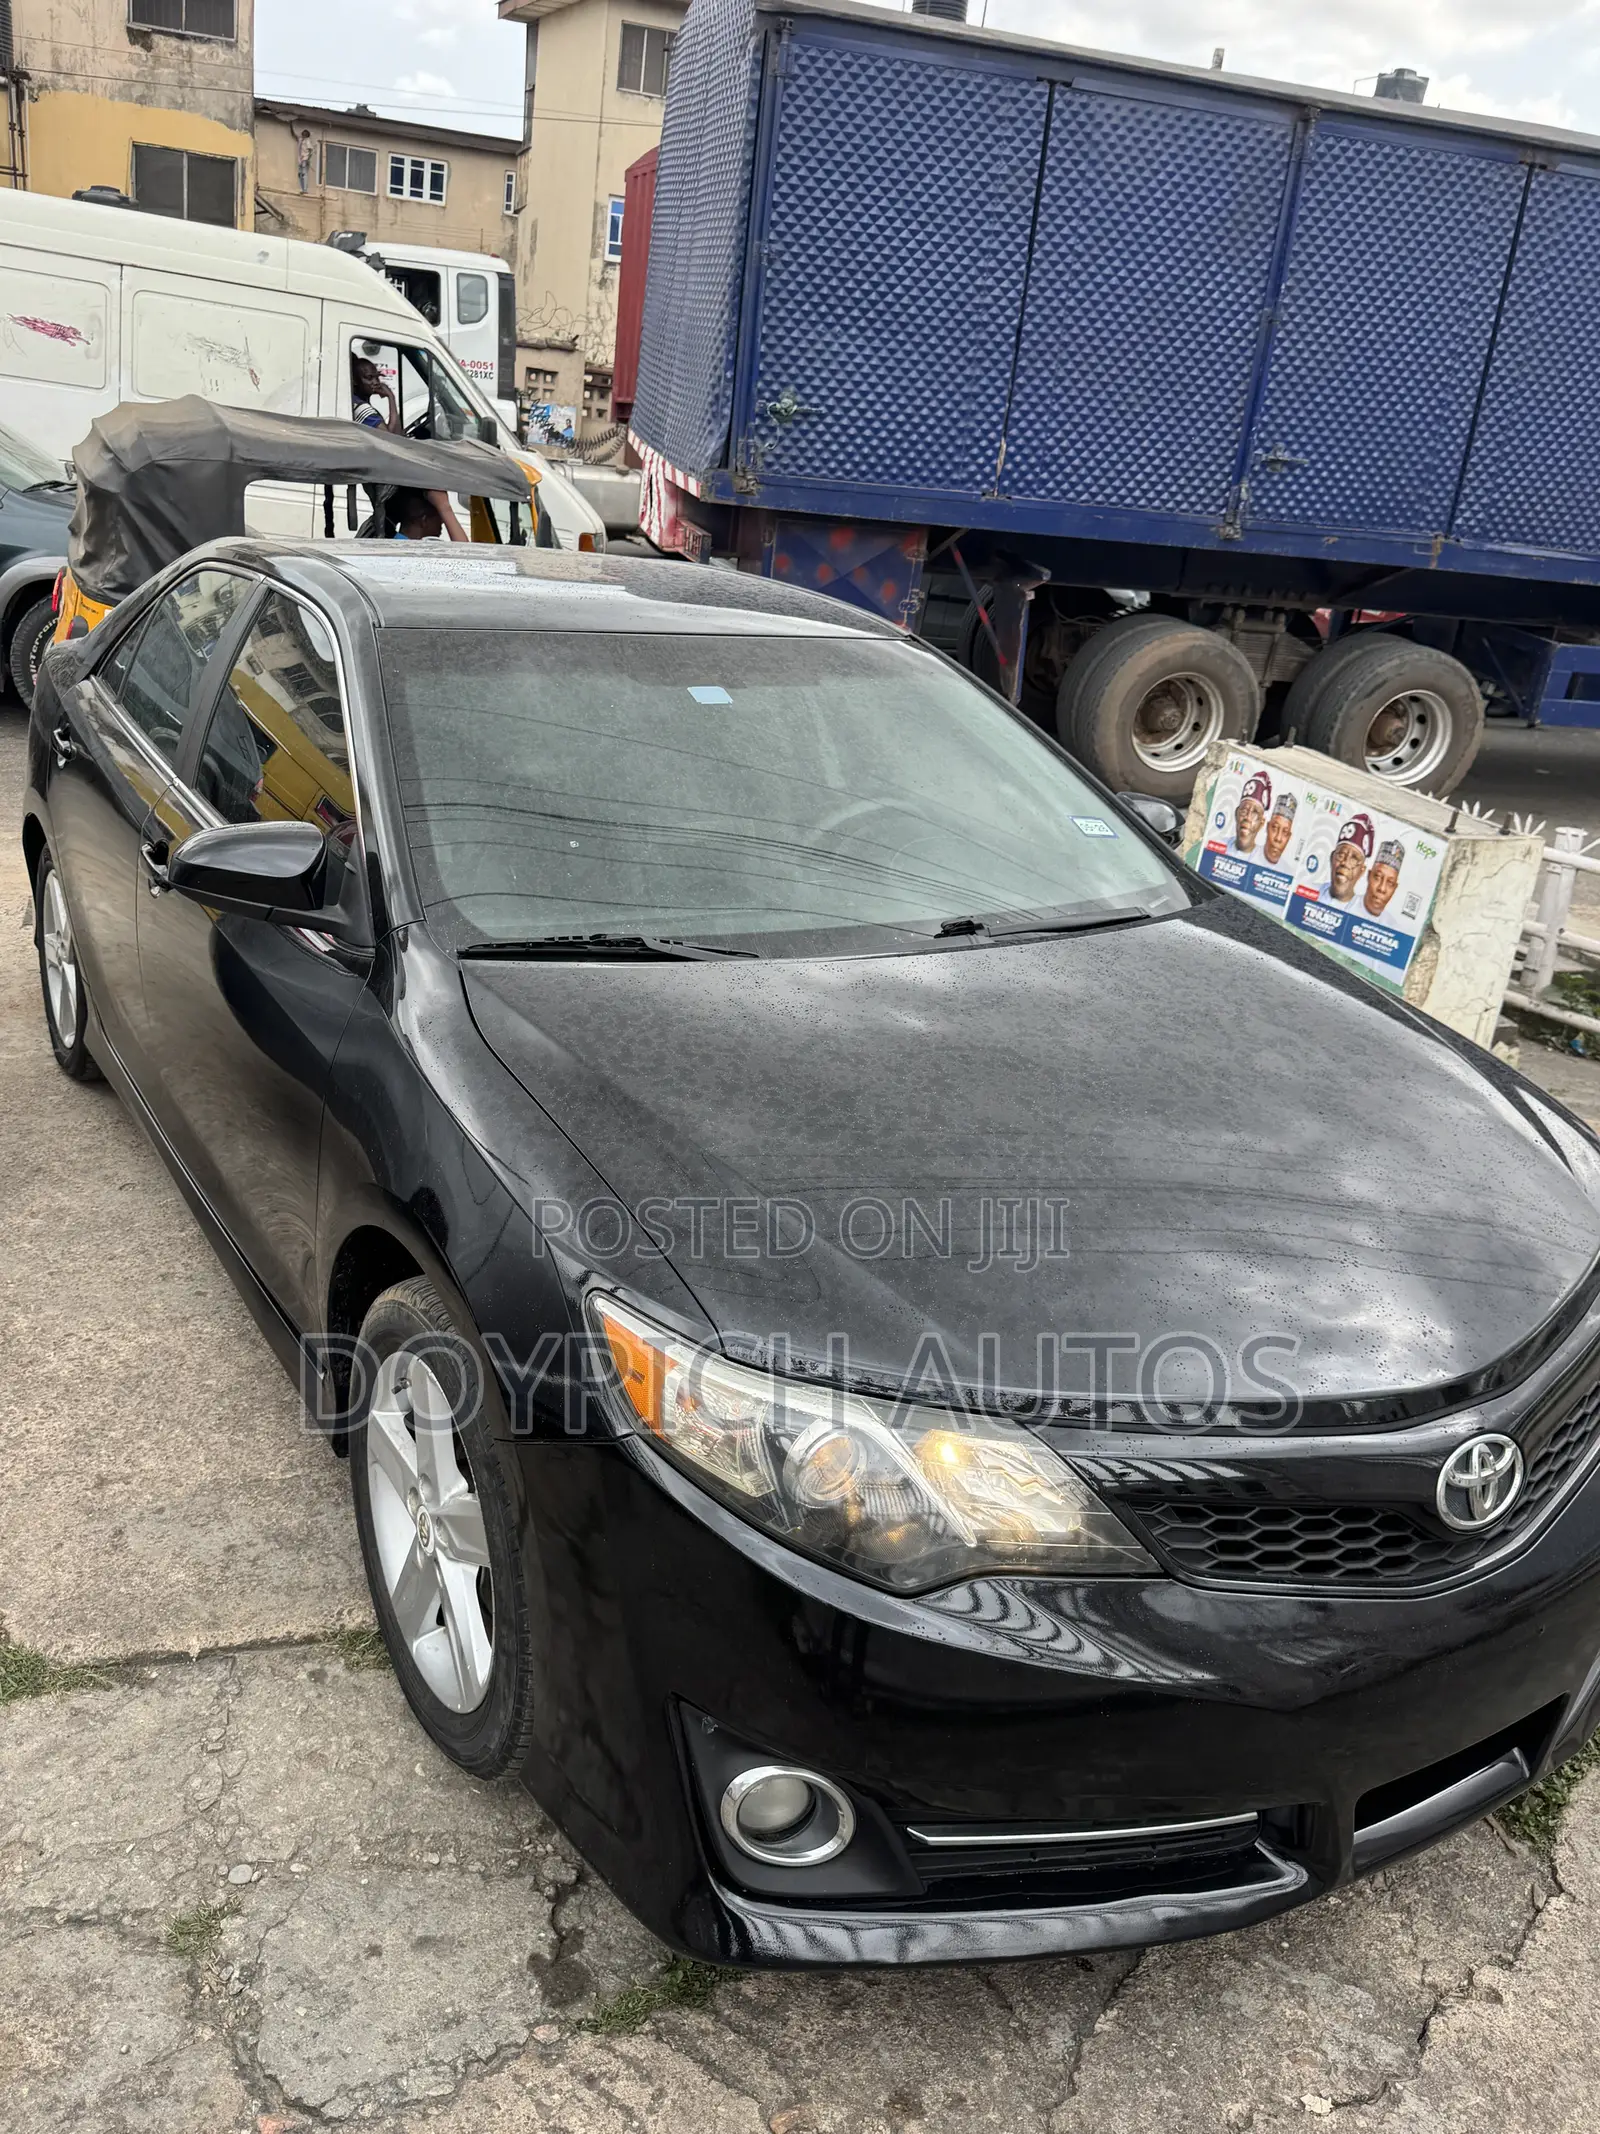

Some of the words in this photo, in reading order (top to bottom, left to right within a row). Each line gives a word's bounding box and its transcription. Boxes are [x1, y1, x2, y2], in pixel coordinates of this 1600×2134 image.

[458, 359, 494, 370] A-0051
[466, 369, 494, 380] 281XC
[1416, 841, 1437, 860] Hope
[1213, 859, 1247, 877] TINUBU
[1303, 906, 1342, 927] TINUBU
